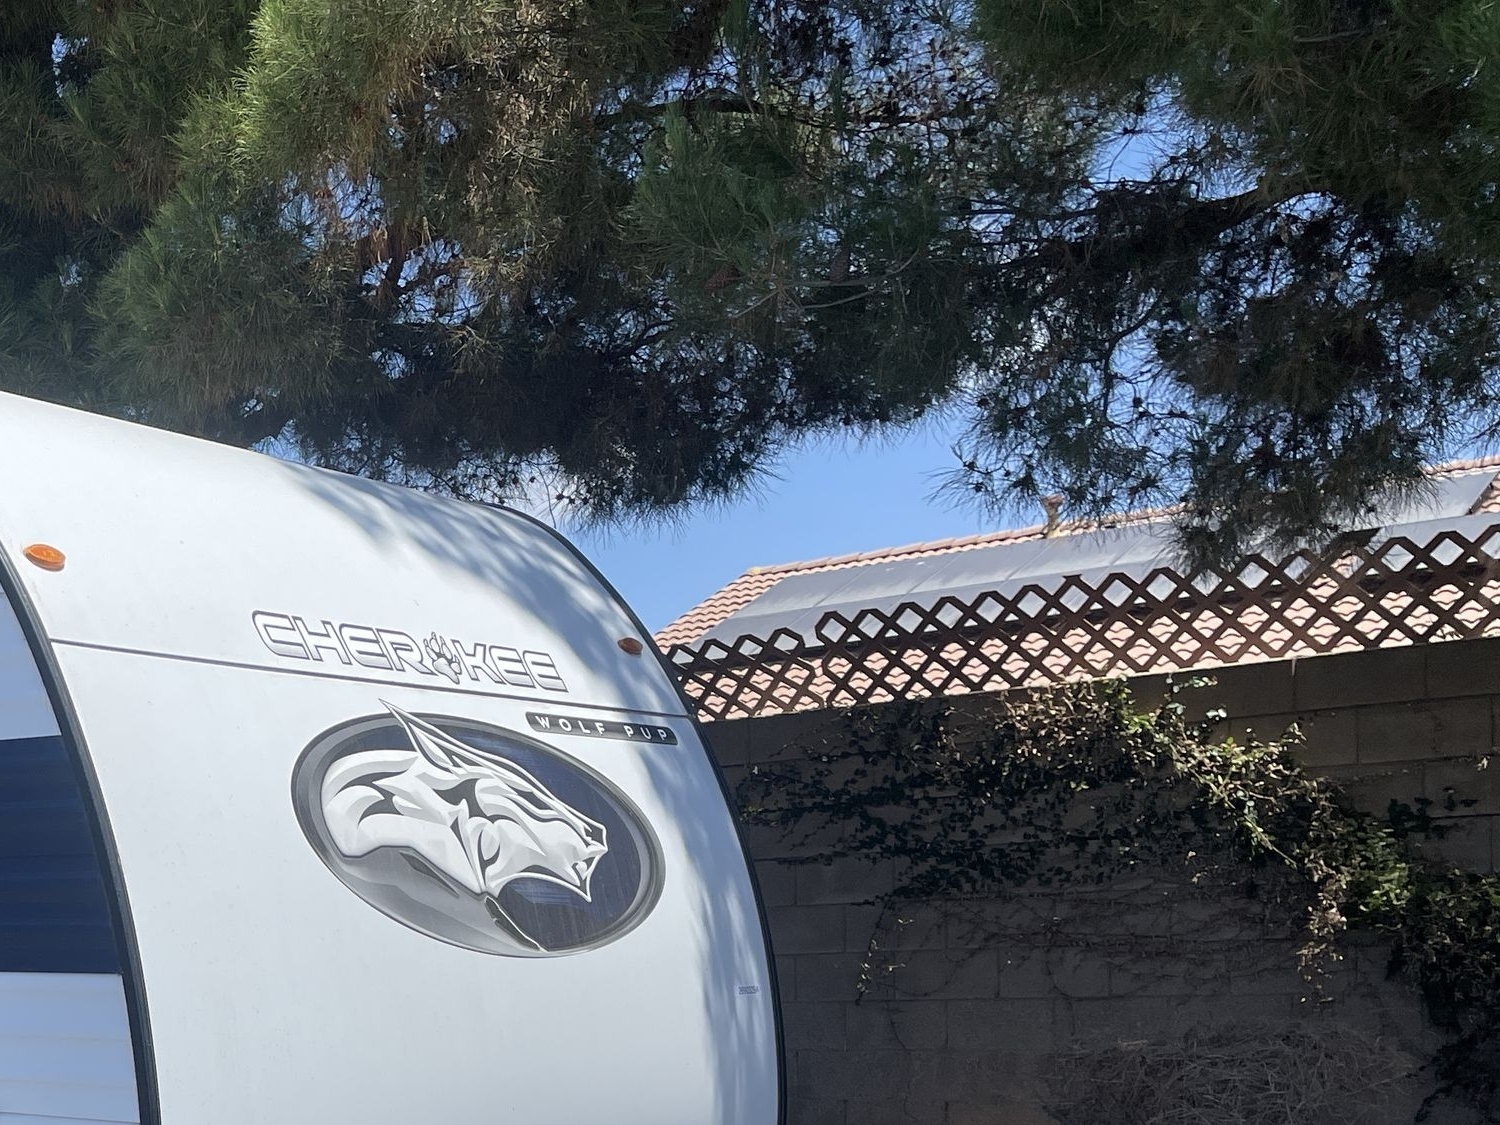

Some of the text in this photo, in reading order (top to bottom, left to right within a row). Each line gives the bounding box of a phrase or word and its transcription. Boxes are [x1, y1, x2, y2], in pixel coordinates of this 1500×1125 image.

[252, 610, 569, 693] CHEROKEE
[534, 715, 667, 741] WOLF PUP
